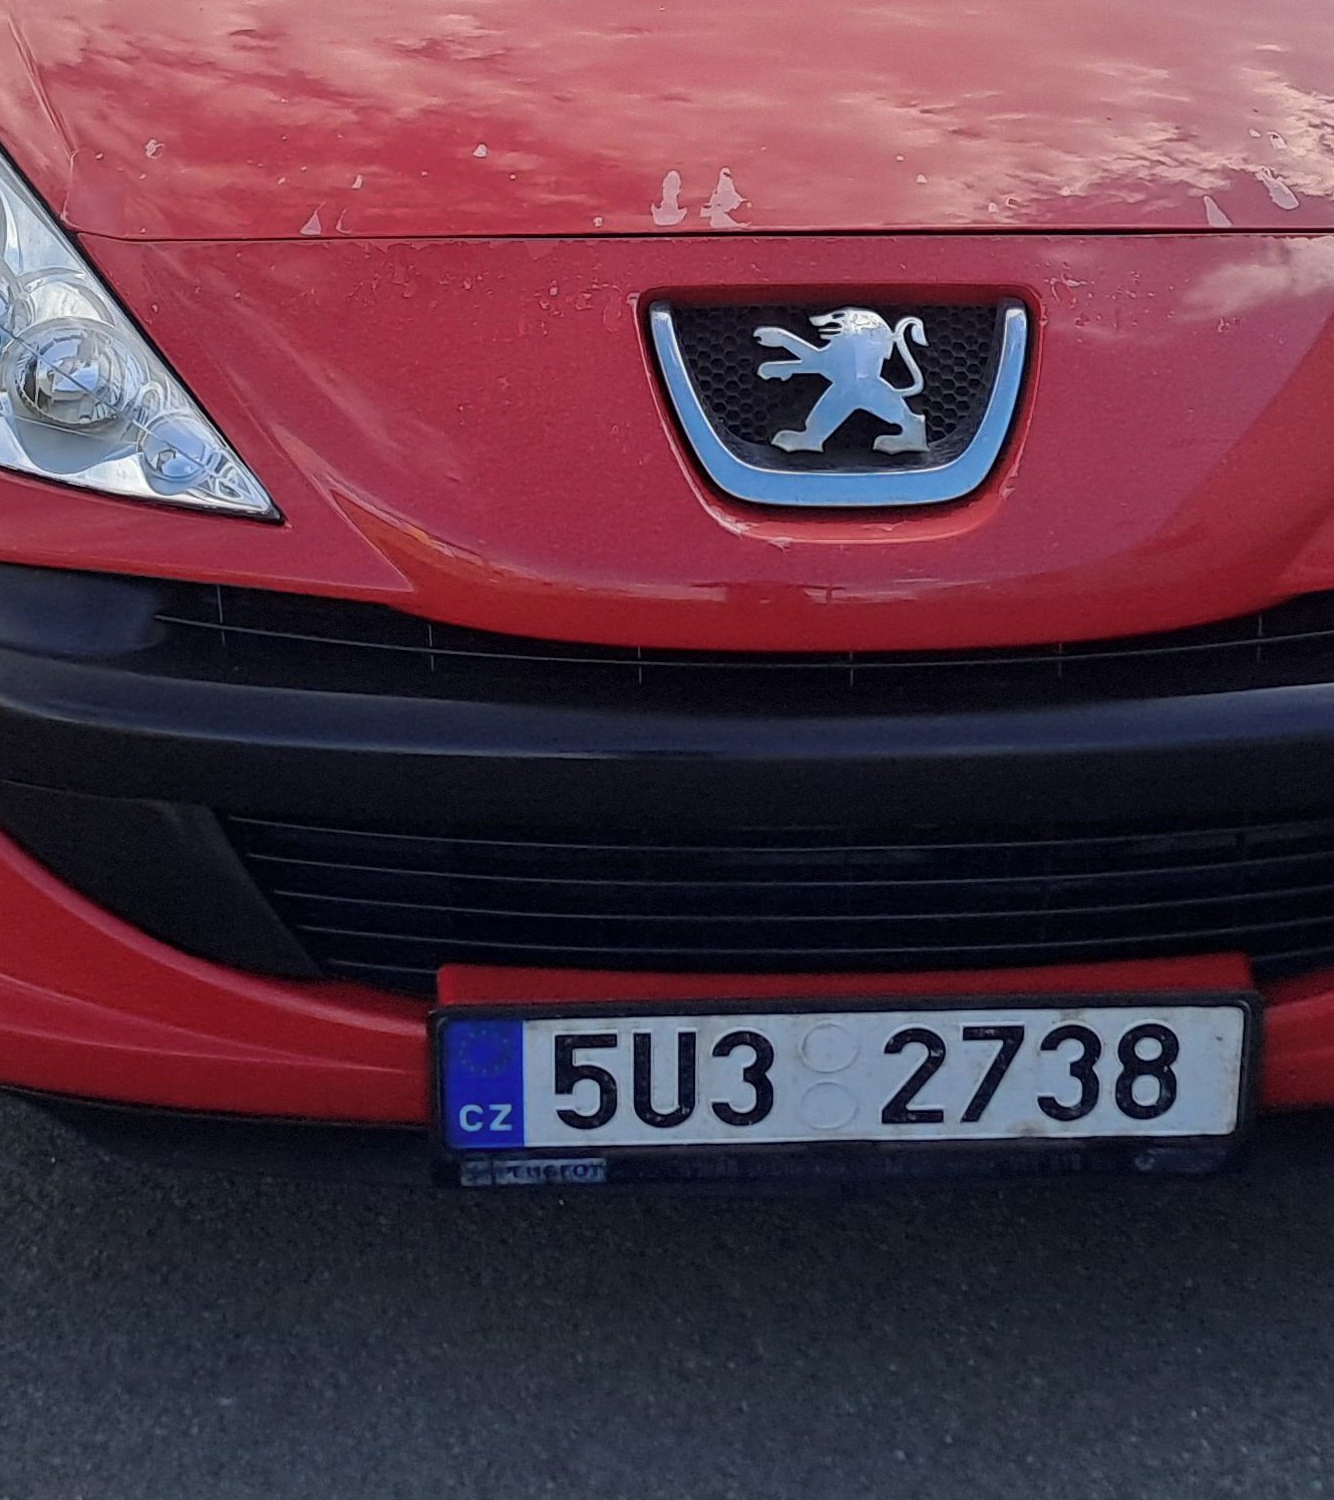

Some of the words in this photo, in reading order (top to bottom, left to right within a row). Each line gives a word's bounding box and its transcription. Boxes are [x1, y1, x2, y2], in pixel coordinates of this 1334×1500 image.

[554, 1030, 775, 1131] 5U3
[880, 1022, 1180, 1125] 2738
[459, 1103, 513, 1132] CZ
